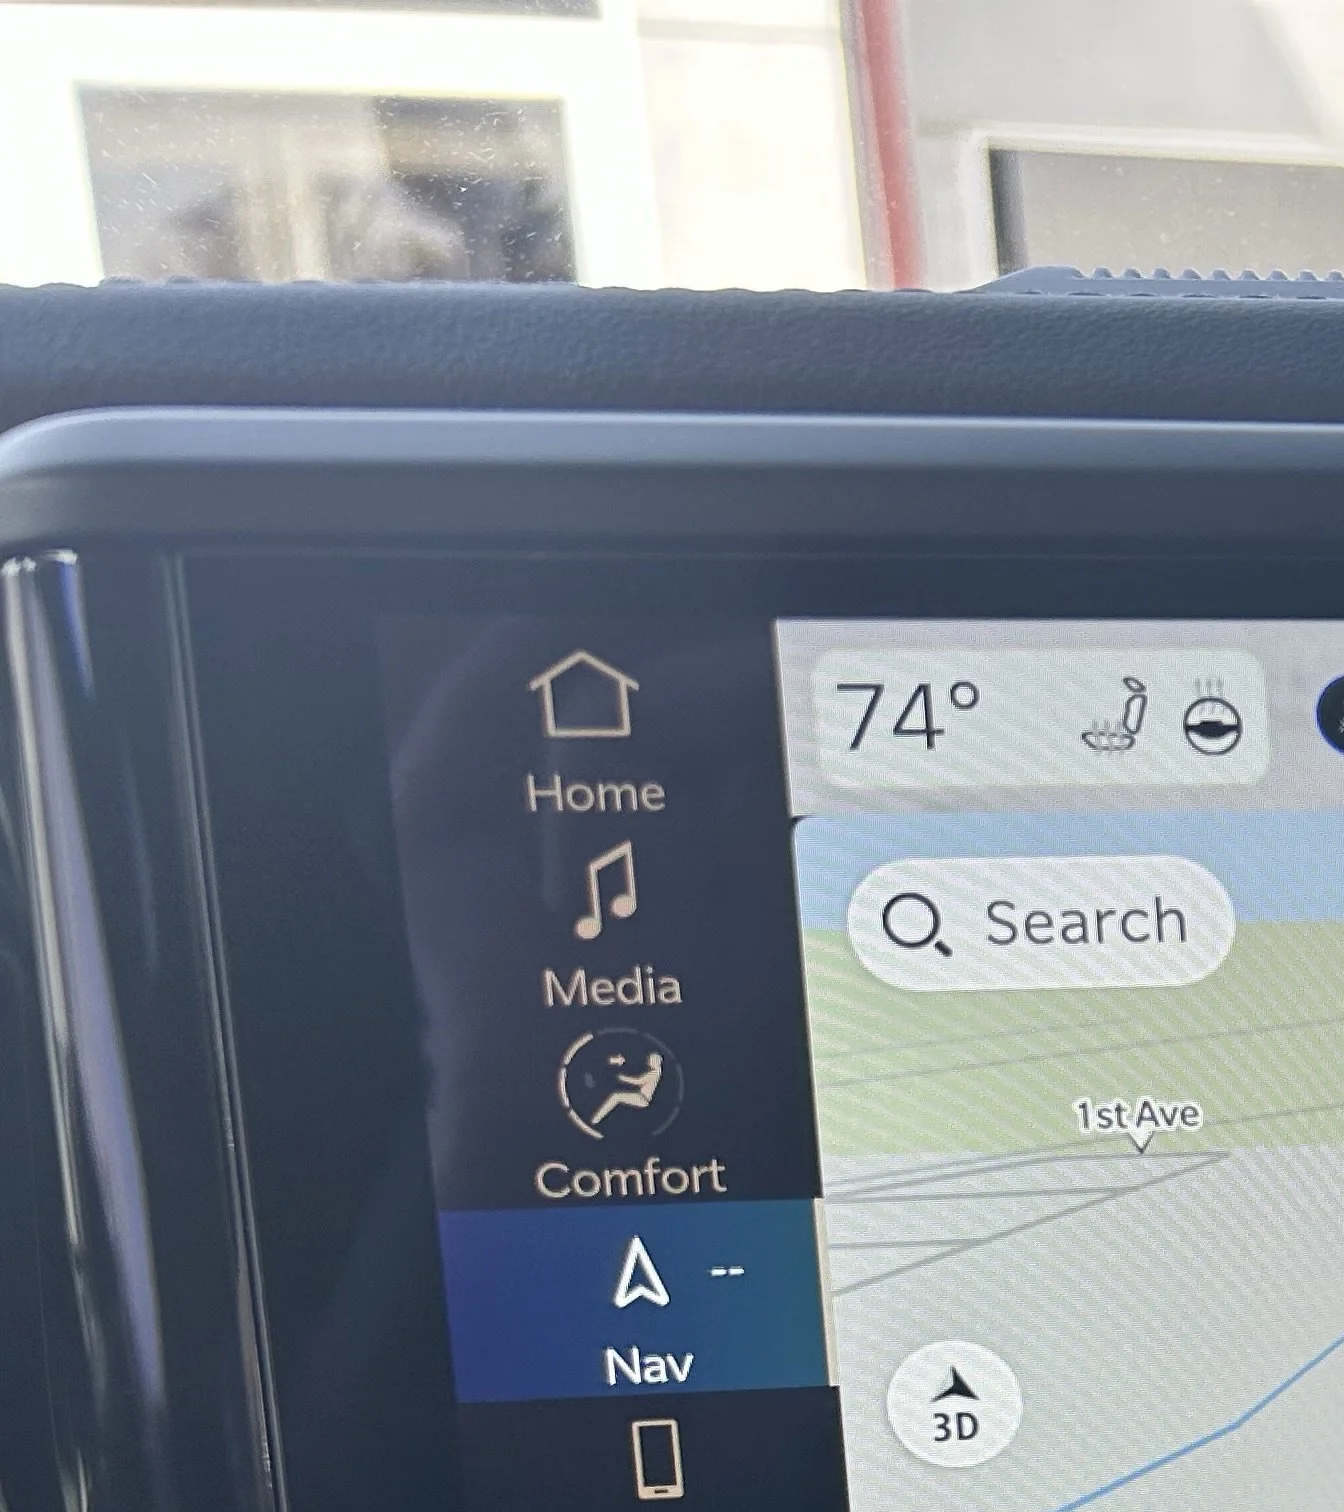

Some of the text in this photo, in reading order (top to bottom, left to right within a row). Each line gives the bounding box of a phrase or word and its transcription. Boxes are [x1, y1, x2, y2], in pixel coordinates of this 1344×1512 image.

[525, 774, 667, 812] Home
[986, 897, 1187, 945] Search
[543, 968, 683, 1007] Media
[1077, 1101, 1201, 1129] 1st Ave
[535, 1158, 728, 1199] Comfort
[603, 1346, 694, 1386] Nav
[933, 1412, 978, 1442] 3D
